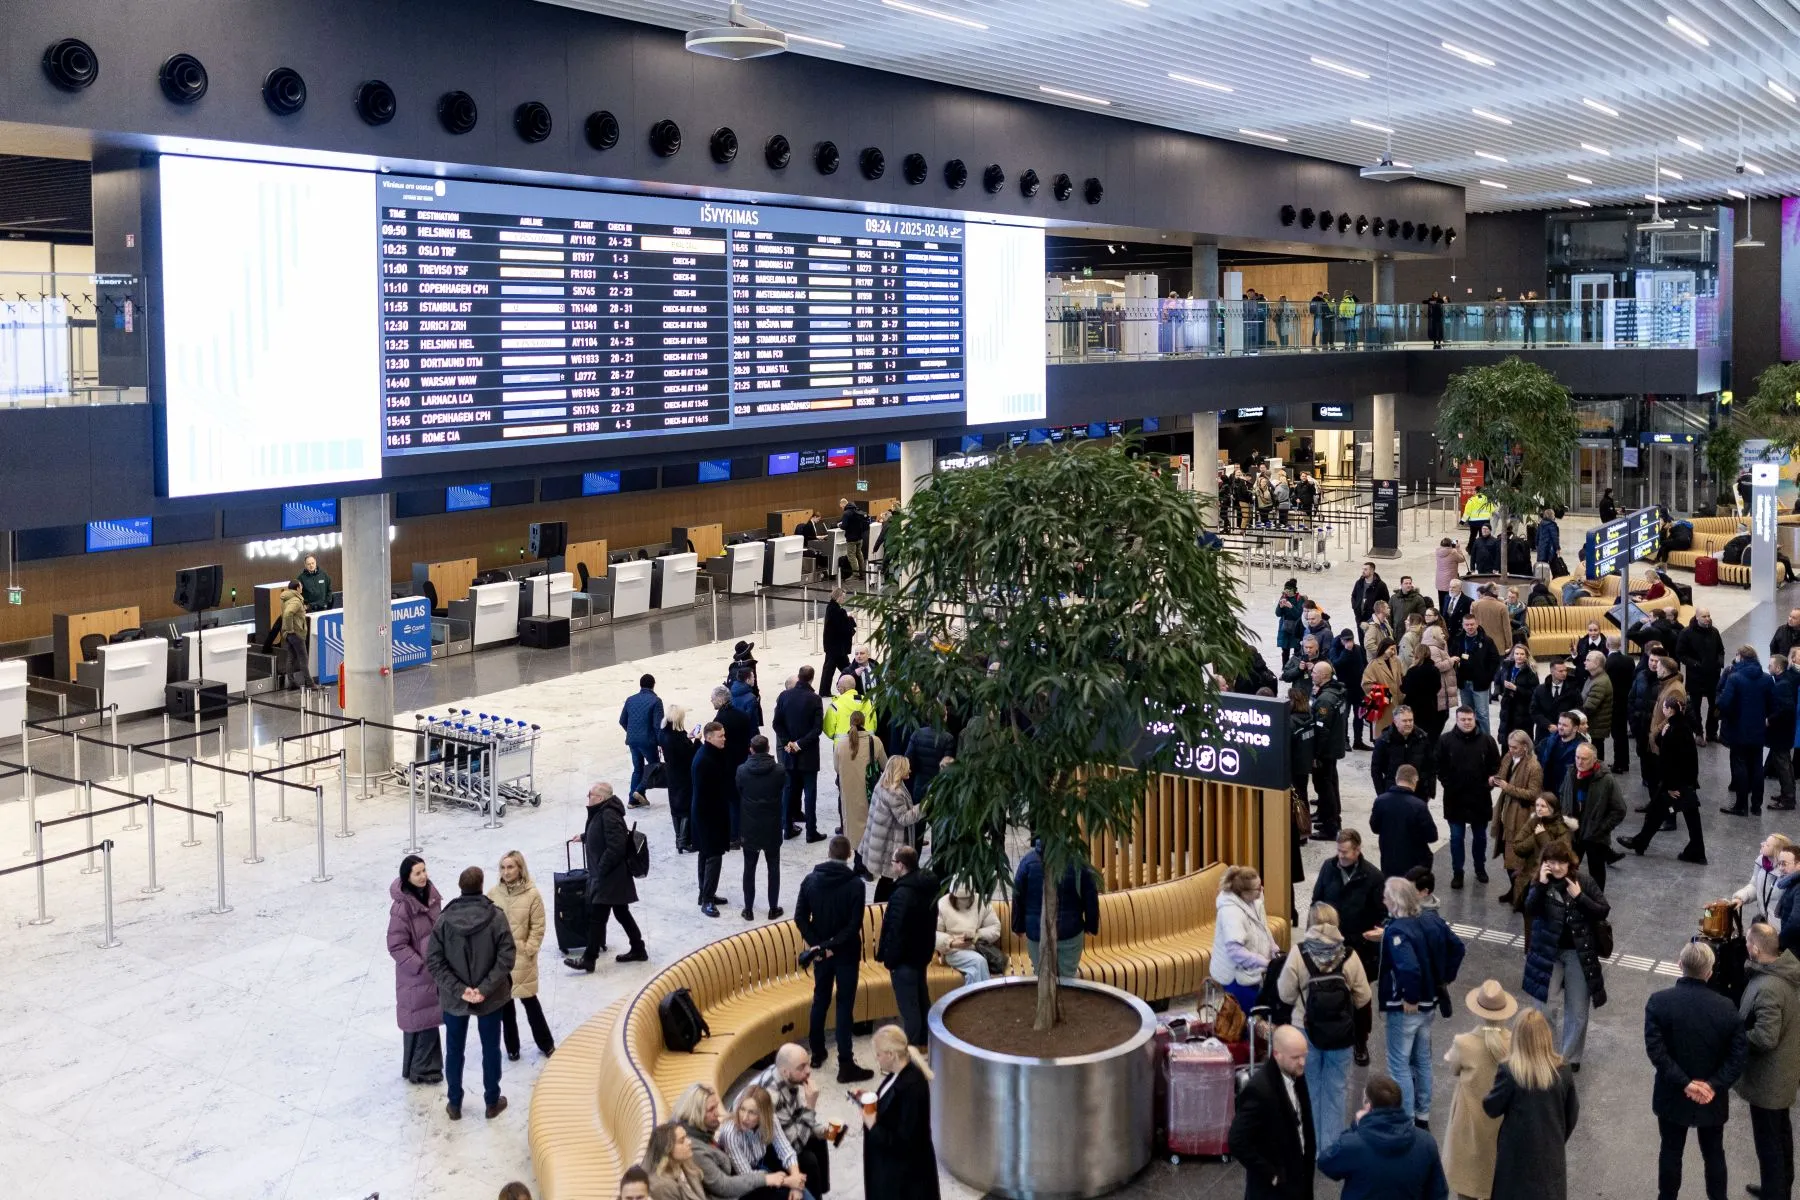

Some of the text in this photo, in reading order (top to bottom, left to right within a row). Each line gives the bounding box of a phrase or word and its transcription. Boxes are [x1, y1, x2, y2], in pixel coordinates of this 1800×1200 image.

[389, 209, 406, 218] TIME
[417, 211, 459, 221] DESTINATION
[574, 220, 594, 229] FLIGHT
[700, 204, 759, 225] IŠVYKIMAS
[382, 225, 407, 236] 09:50
[418, 227, 455, 238] HELSINKI
[456, 229, 472, 239] HEL
[570, 235, 596, 245] AY1102
[866, 219, 891, 234] 09:24
[900, 222, 949, 237] 2025-02-04
[383, 244, 407, 255] 10:25
[418, 245, 439, 256] OSLO
[441, 247, 456, 256] TRF
[572, 252, 595, 262] BT917
[673, 257, 696, 265] CHECK-IN
[383, 264, 407, 274] 11:00
[419, 264, 452, 275] TREVISO
[454, 265, 469, 275] TSF
[571, 269, 596, 279] FR1831
[673, 273, 696, 281] CHECK-IN
[384, 283, 408, 293] 11:10
[419, 283, 471, 294] COPENHAGEN
[472, 284, 489, 294] CPH
[572, 287, 596, 296] SK745
[674, 289, 697, 297] CHECK-IN
[384, 302, 408, 312] 11:55
[420, 302, 458, 312] ISTANBUL
[459, 302, 472, 312] IST
[663, 305, 686, 313] CHECK-IN
[384, 321, 409, 331] 12:30
[420, 321, 449, 331] ZURICH
[451, 321, 466, 331] ZRH
[571, 321, 597, 330] LX1341
[385, 340, 409, 350] 13:25
[420, 339, 457, 350] HELSINKI
[459, 339, 475, 349] HEL
[572, 337, 598, 347] AY1104
[386, 358, 410, 369] 13:30
[421, 357, 465, 369] DORTMUND
[466, 357, 483, 367] DTM
[664, 353, 686, 361] CHECK-IN
[386, 377, 410, 388] 14:40
[421, 376, 456, 387] WARSAW
[457, 375, 477, 386] WAW
[664, 369, 686, 377] CHECK-IN
[387, 396, 410, 408] 15:40
[422, 395, 457, 406] LARNACA
[459, 394, 474, 404] LCA
[664, 385, 686, 393] CHECK-IN
[387, 415, 411, 427] 15:45
[422, 412, 474, 425] COPENHAGEN
[475, 411, 491, 421] CPH
[572, 405, 600, 415] SK1743
[664, 401, 687, 409] CHECK-IN
[387, 434, 411, 446] 16:15
[422, 432, 445, 443] ROME
[446, 431, 460, 441] CIA
[573, 421, 600, 432] FR1309
[664, 417, 687, 425] CHECK-IN
[391, 605, 425, 622] INALAS
